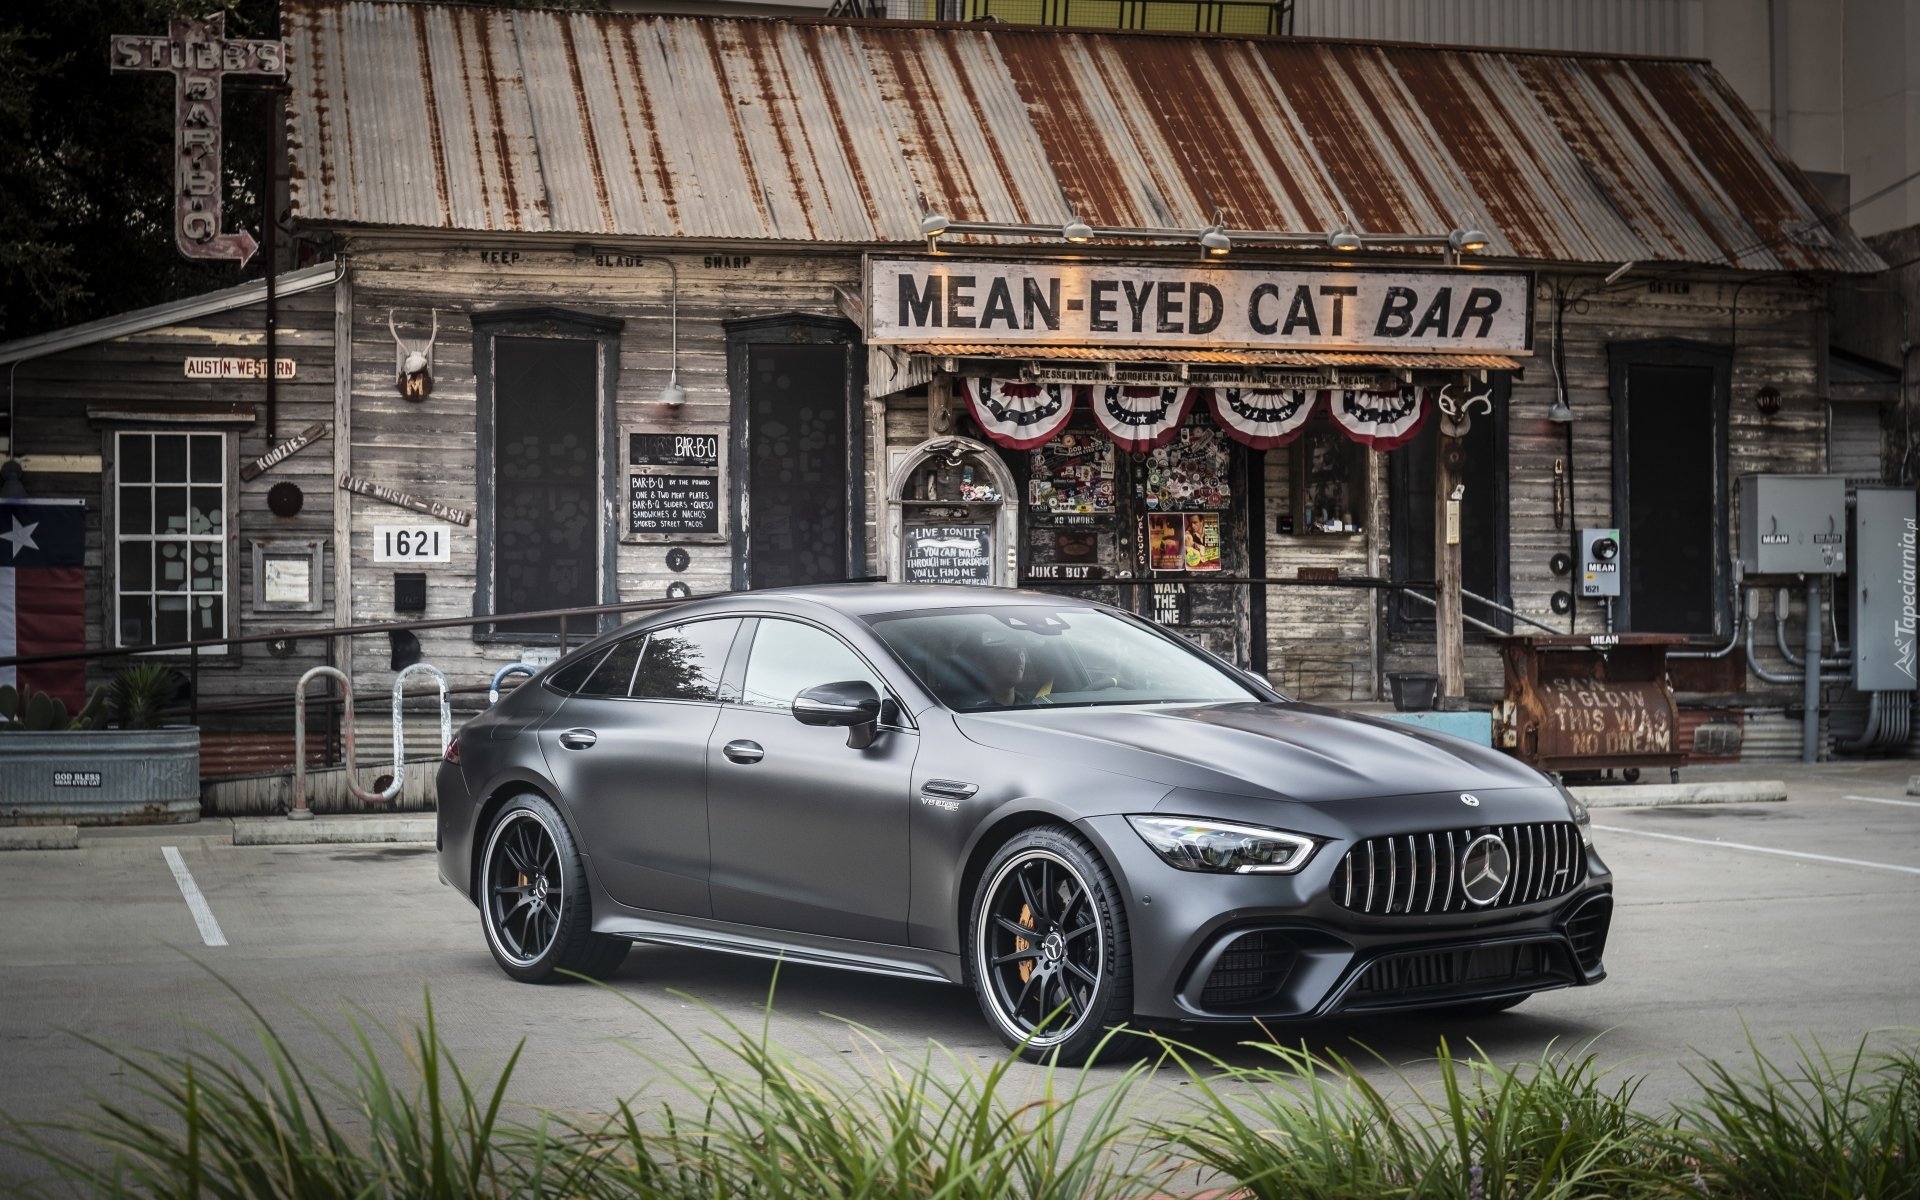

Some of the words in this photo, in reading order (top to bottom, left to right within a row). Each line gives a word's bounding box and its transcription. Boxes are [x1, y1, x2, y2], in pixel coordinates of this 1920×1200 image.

[481, 251, 520, 264] KEEP
[595, 255, 644, 267] BLADE
[703, 255, 751, 269] SHARP
[899, 273, 1225, 336] MEAN-EYED
[1249, 284, 1358, 338] CAT
[1373, 286, 1502, 339] BAR
[188, 359, 293, 376] AUSTIN-WESTRN
[406, 373, 424, 395] M
[256, 433, 308, 471] KOOZIES
[675, 436, 716, 458] BAR-B-Q
[340, 475, 370, 493] LIVE
[431, 502, 467, 524] CASH
[636, 491, 648, 500] ONE
[657, 491, 669, 500] TWO
[689, 491, 710, 500] PLATES
[664, 501, 688, 509] SLIDERS
[682, 510, 707, 519] NACHOS
[634, 520, 657, 528] SMOKED
[660, 520, 680, 528] STREET
[684, 520, 704, 528] TACOS
[916, 528, 939, 539] LIVE
[942, 528, 981, 540] TONITE
[1763, 535, 1788, 543] MEAN
[386, 530, 439, 557] 1621
[923, 547, 940, 557] YOU
[940, 547, 957, 557] CAN
[958, 548, 983, 557] WADE
[906, 556, 939, 568] THROUGH
[1588, 563, 1615, 572] MEAN
[912, 567, 939, 578] YOU'LL
[939, 568, 960, 578] FIND
[961, 568, 977, 577] ME
[1028, 565, 1059, 578] JUKE
[1154, 583, 1186, 594] WALK
[1585, 585, 1599, 593] 1621
[1154, 594, 1177, 608] THE
[1154, 610, 1180, 624] LINE
[1590, 635, 1619, 645] MEAN
[1578, 690, 1645, 708] GLOW
[1554, 707, 1605, 732] THIS
[1605, 729, 1670, 754] DREAM
[54, 772, 73, 781] GOD
[74, 773, 100, 781] BLESS
[1100, 900, 1115, 973] MICHELIN
